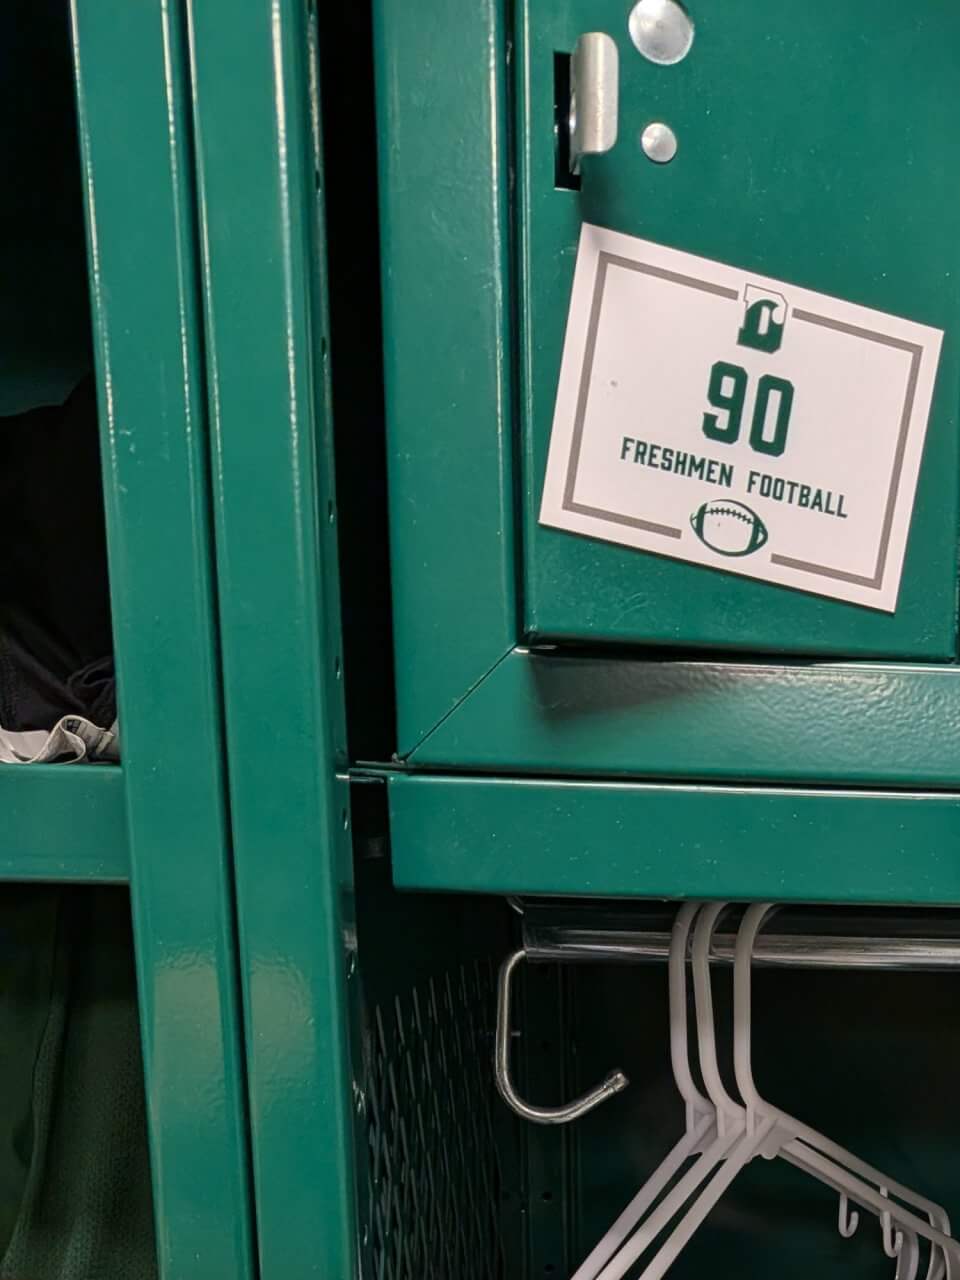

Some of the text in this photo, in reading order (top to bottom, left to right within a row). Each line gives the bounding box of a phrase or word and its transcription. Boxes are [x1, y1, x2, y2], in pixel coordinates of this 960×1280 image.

[702, 360, 794, 457] 90
[620, 436, 847, 517] FRESHMEN FOOTBALL
